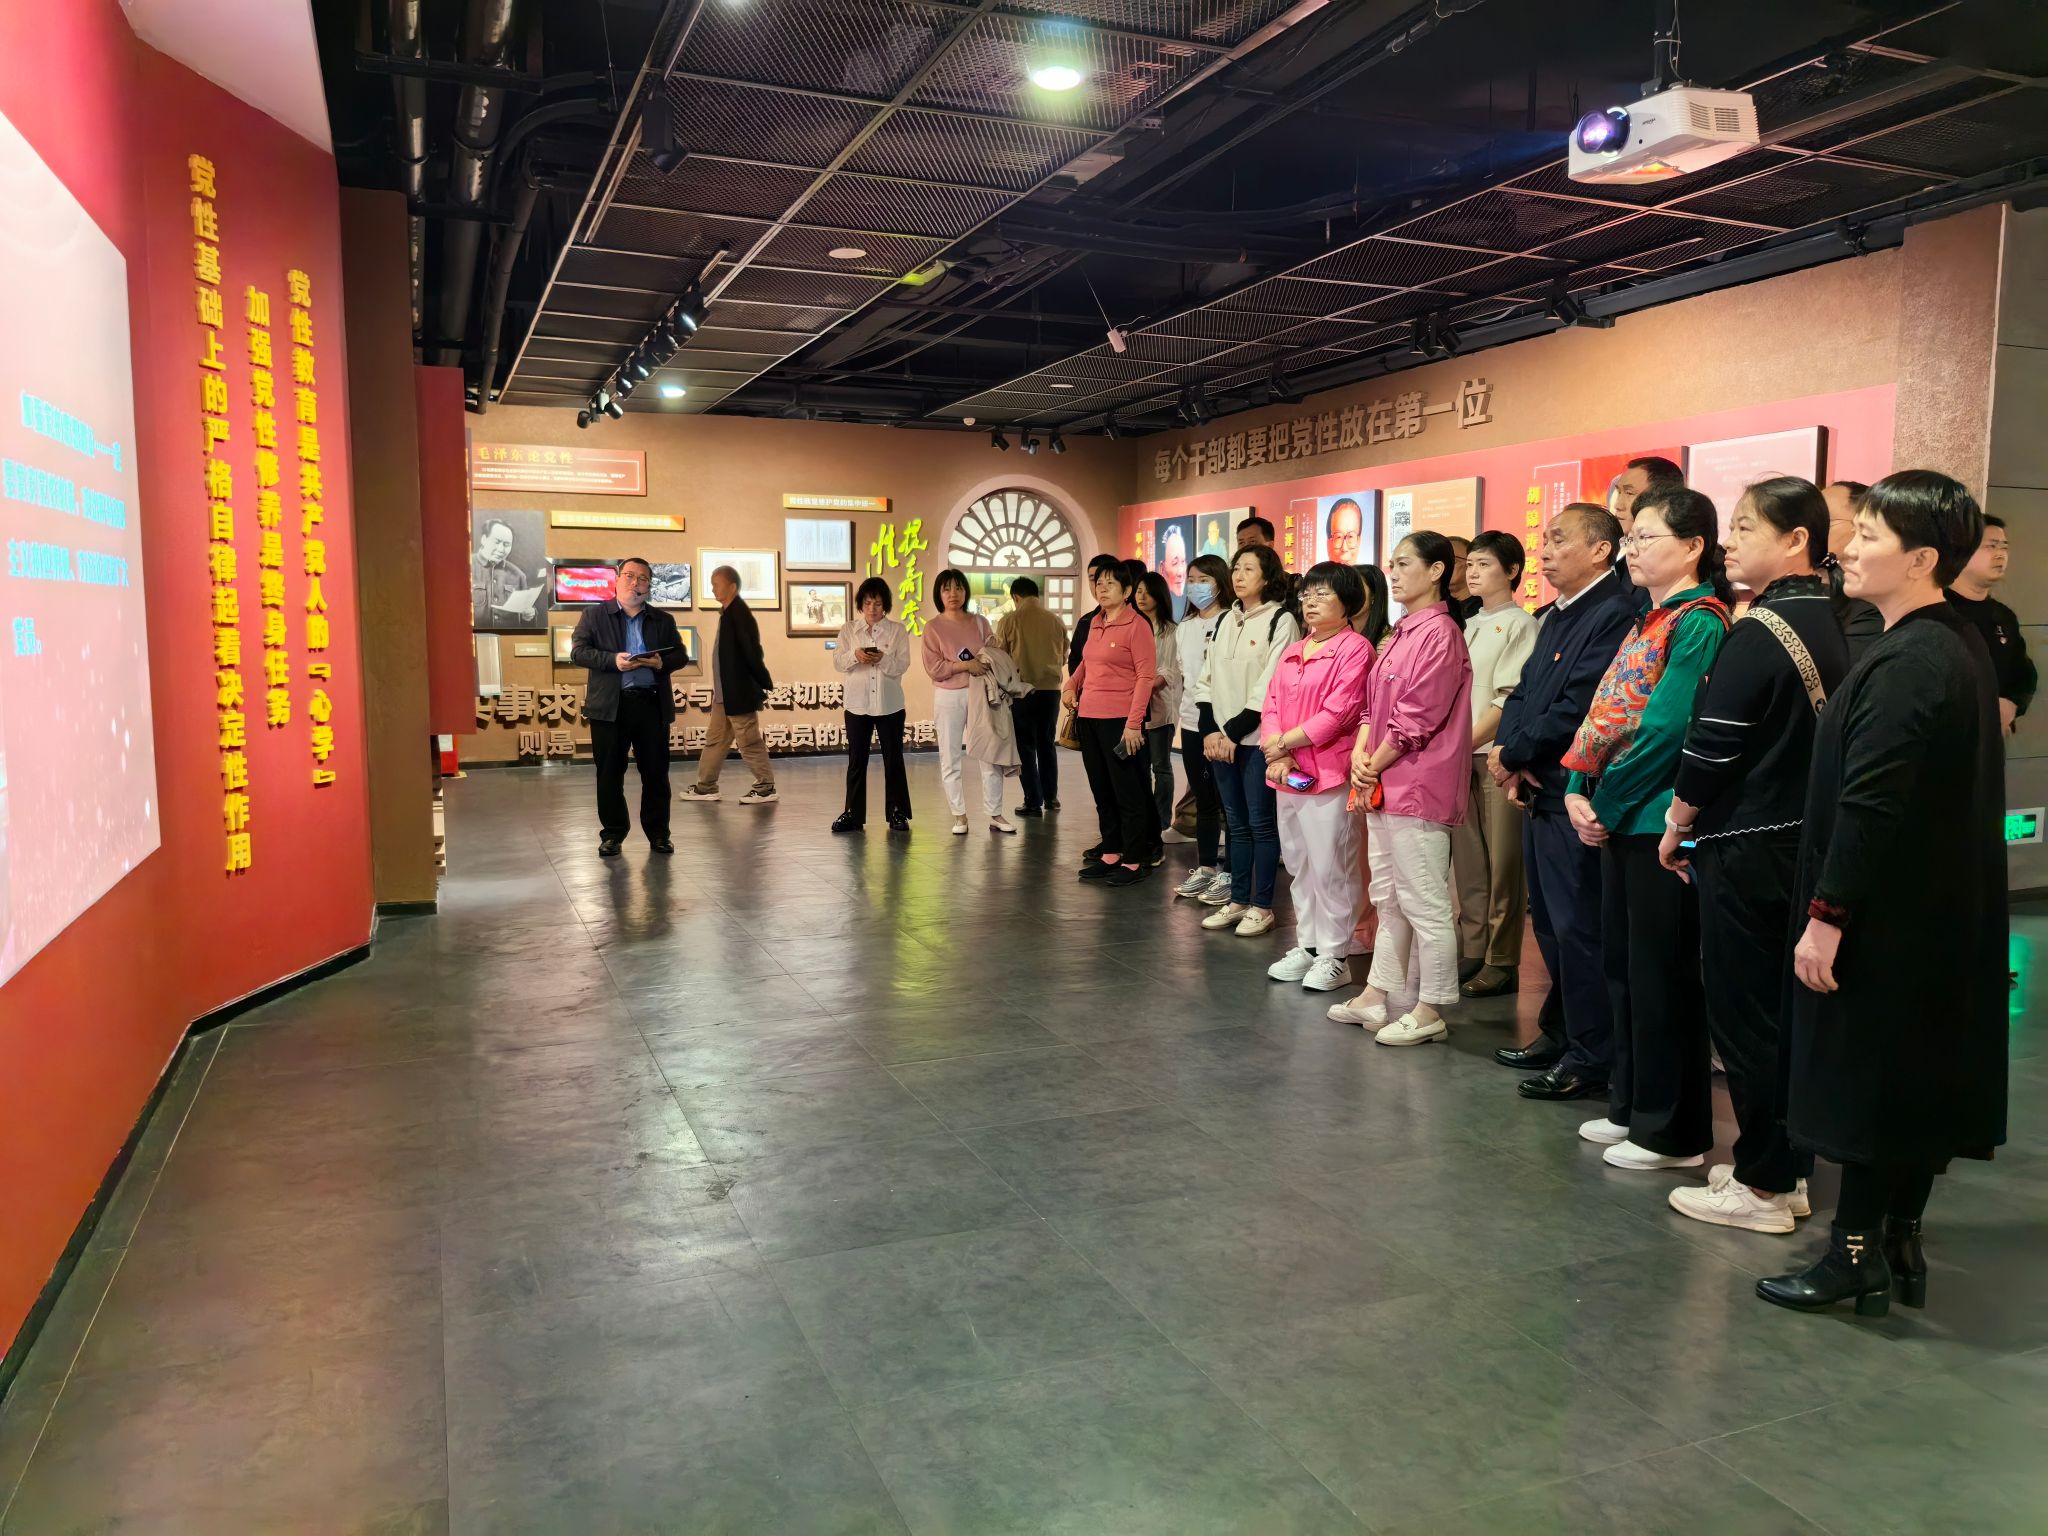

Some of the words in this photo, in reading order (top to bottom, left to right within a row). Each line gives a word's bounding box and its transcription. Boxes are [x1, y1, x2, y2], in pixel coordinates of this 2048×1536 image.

[1153, 377, 1493, 484] 每个干部都要把党性放在第一位
